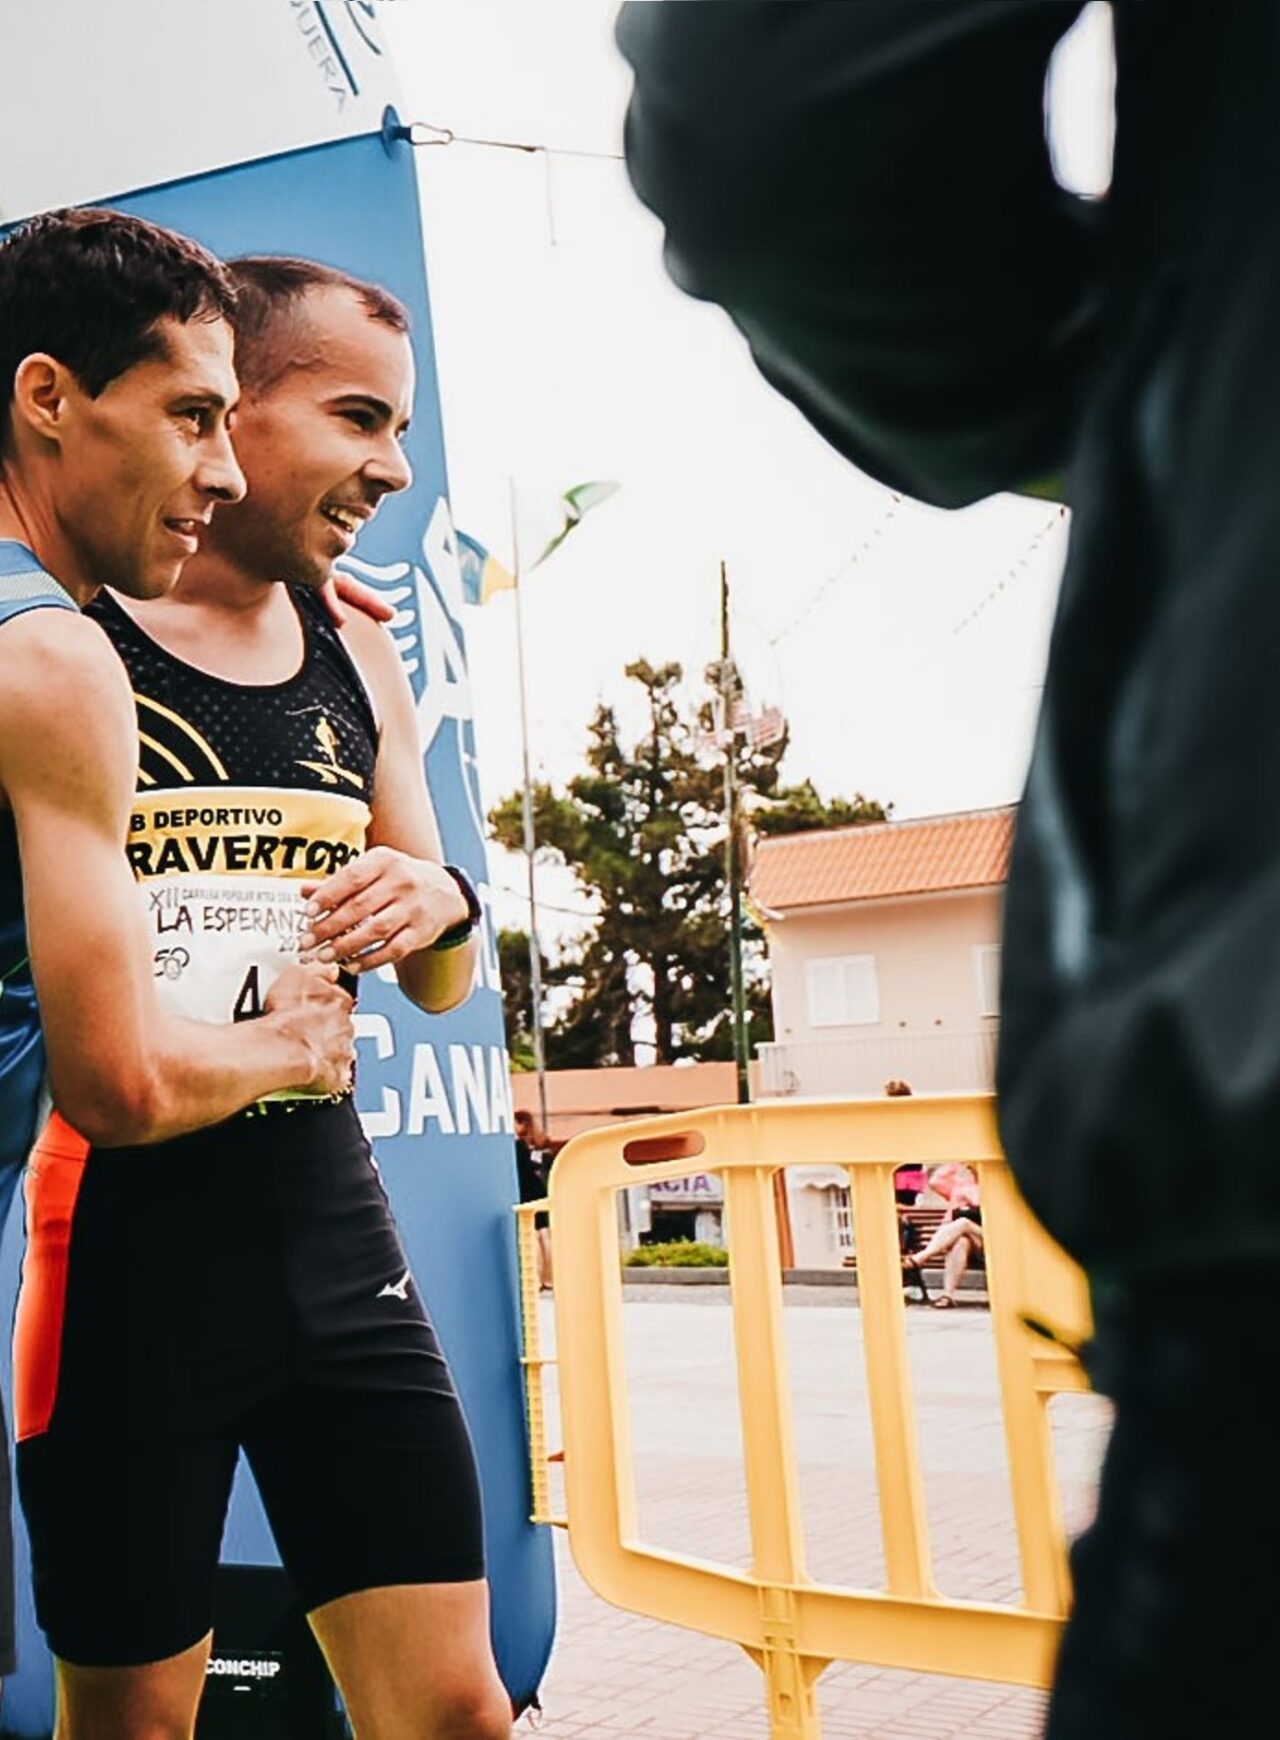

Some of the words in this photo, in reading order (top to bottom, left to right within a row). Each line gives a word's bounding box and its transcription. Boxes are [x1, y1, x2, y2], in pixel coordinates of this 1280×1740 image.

[290, 0, 347, 114] UERA
[153, 808, 283, 830] DEPORTIVO
[157, 905, 194, 934] LA
[206, 1657, 280, 1677] CONCHIP
